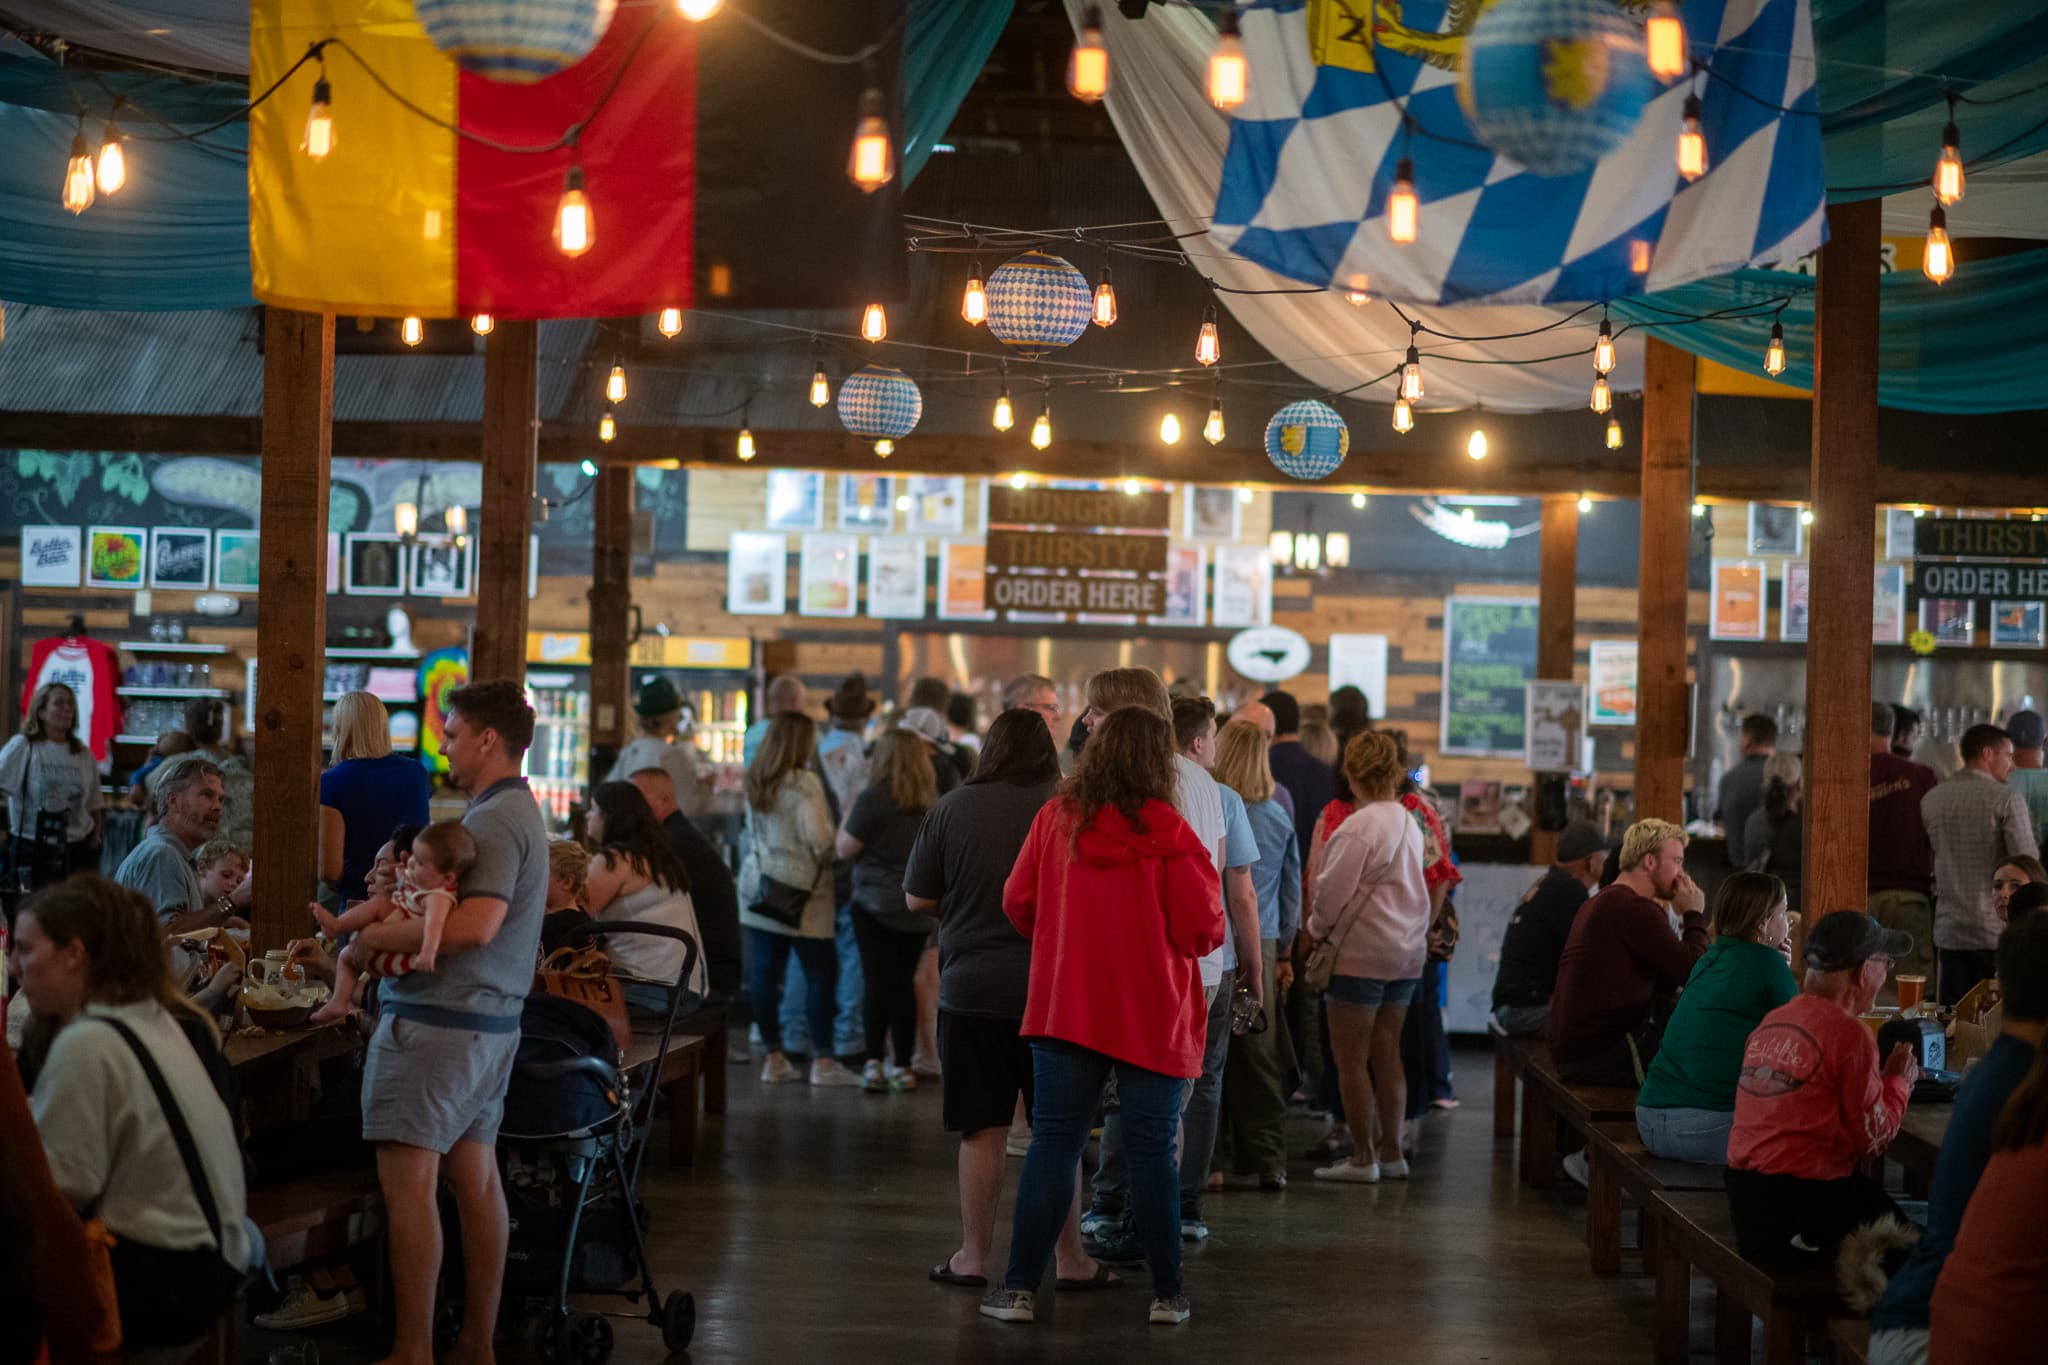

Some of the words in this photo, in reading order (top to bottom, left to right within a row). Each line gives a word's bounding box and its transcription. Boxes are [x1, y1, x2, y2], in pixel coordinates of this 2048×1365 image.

[1007, 535, 1151, 568] THIRSTY?
[994, 578, 1081, 607] ORDER
[1087, 581, 1157, 610] HERE
[1924, 567, 2010, 594] ORDER
